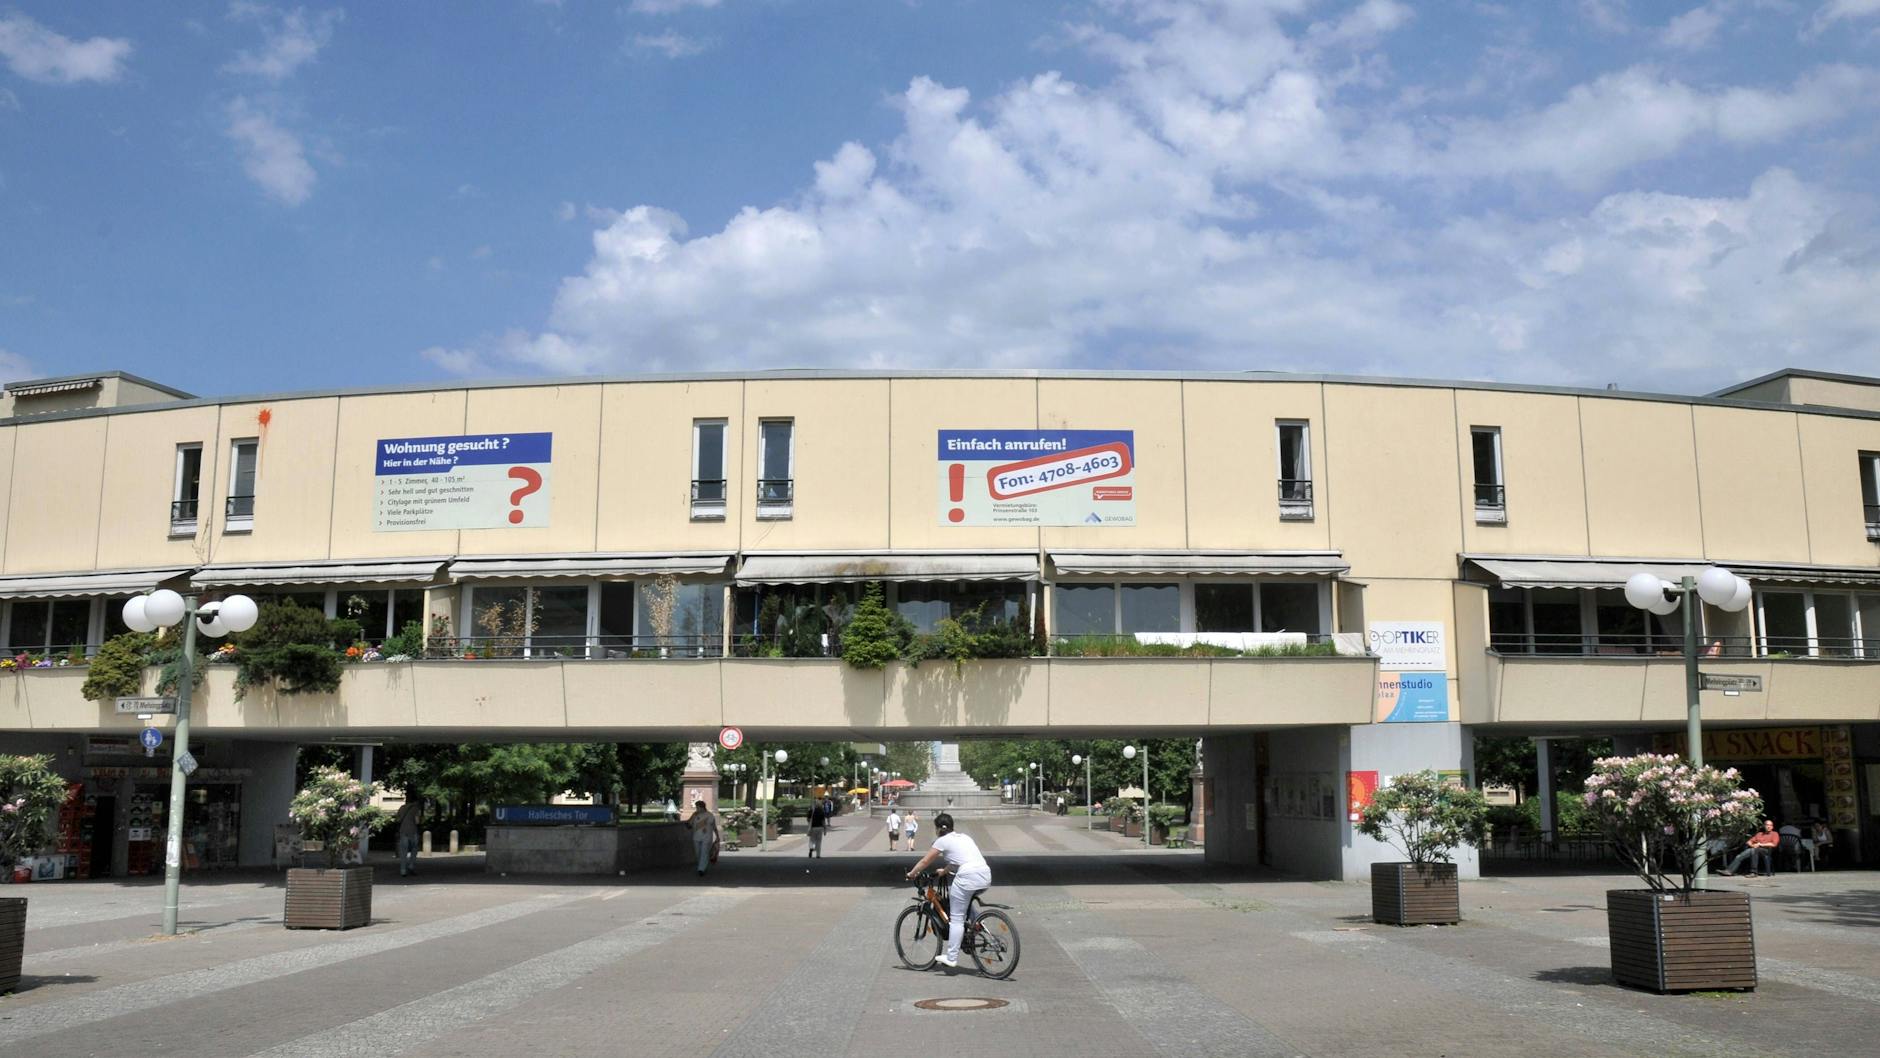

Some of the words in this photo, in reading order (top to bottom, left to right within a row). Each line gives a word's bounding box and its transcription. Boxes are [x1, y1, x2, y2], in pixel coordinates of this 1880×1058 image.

[384, 441, 445, 455] Wohnung
[447, 438, 499, 454] gesucht
[502, 437, 511, 449] ?
[947, 438, 1002, 450] Einfach
[1004, 438, 1067, 450] anrufen!
[383, 458, 402, 467] Hier
[403, 458, 412, 466] in
[413, 457, 428, 466] der
[429, 456, 451, 465] Nähe
[453, 456, 459, 464] ?
[998, 473, 1035, 490] Fon:
[1038, 455, 1120, 484] 4708-4603
[444, 476, 455, 484] 105
[388, 487, 401, 496] Sehr
[402, 486, 414, 495] hell
[415, 486, 427, 495] und
[427, 486, 438, 496] gut
[438, 485, 474, 496] geschnitten
[387, 498, 411, 507] Citylage
[412, 497, 423, 505] mit
[423, 496, 447, 506] grünem
[448, 495, 470, 504] Umfeld
[386, 508, 402, 516] Viele
[402, 507, 434, 517] Parkplätze
[386, 518, 427, 527] Provisionsfrei
[1382, 630, 1439, 644] OPTIKER
[1727, 730, 1816, 756] SNACK
[495, 807, 505, 820] U
[528, 809, 572, 820] Hallesches
[575, 809, 588, 820] Tor
